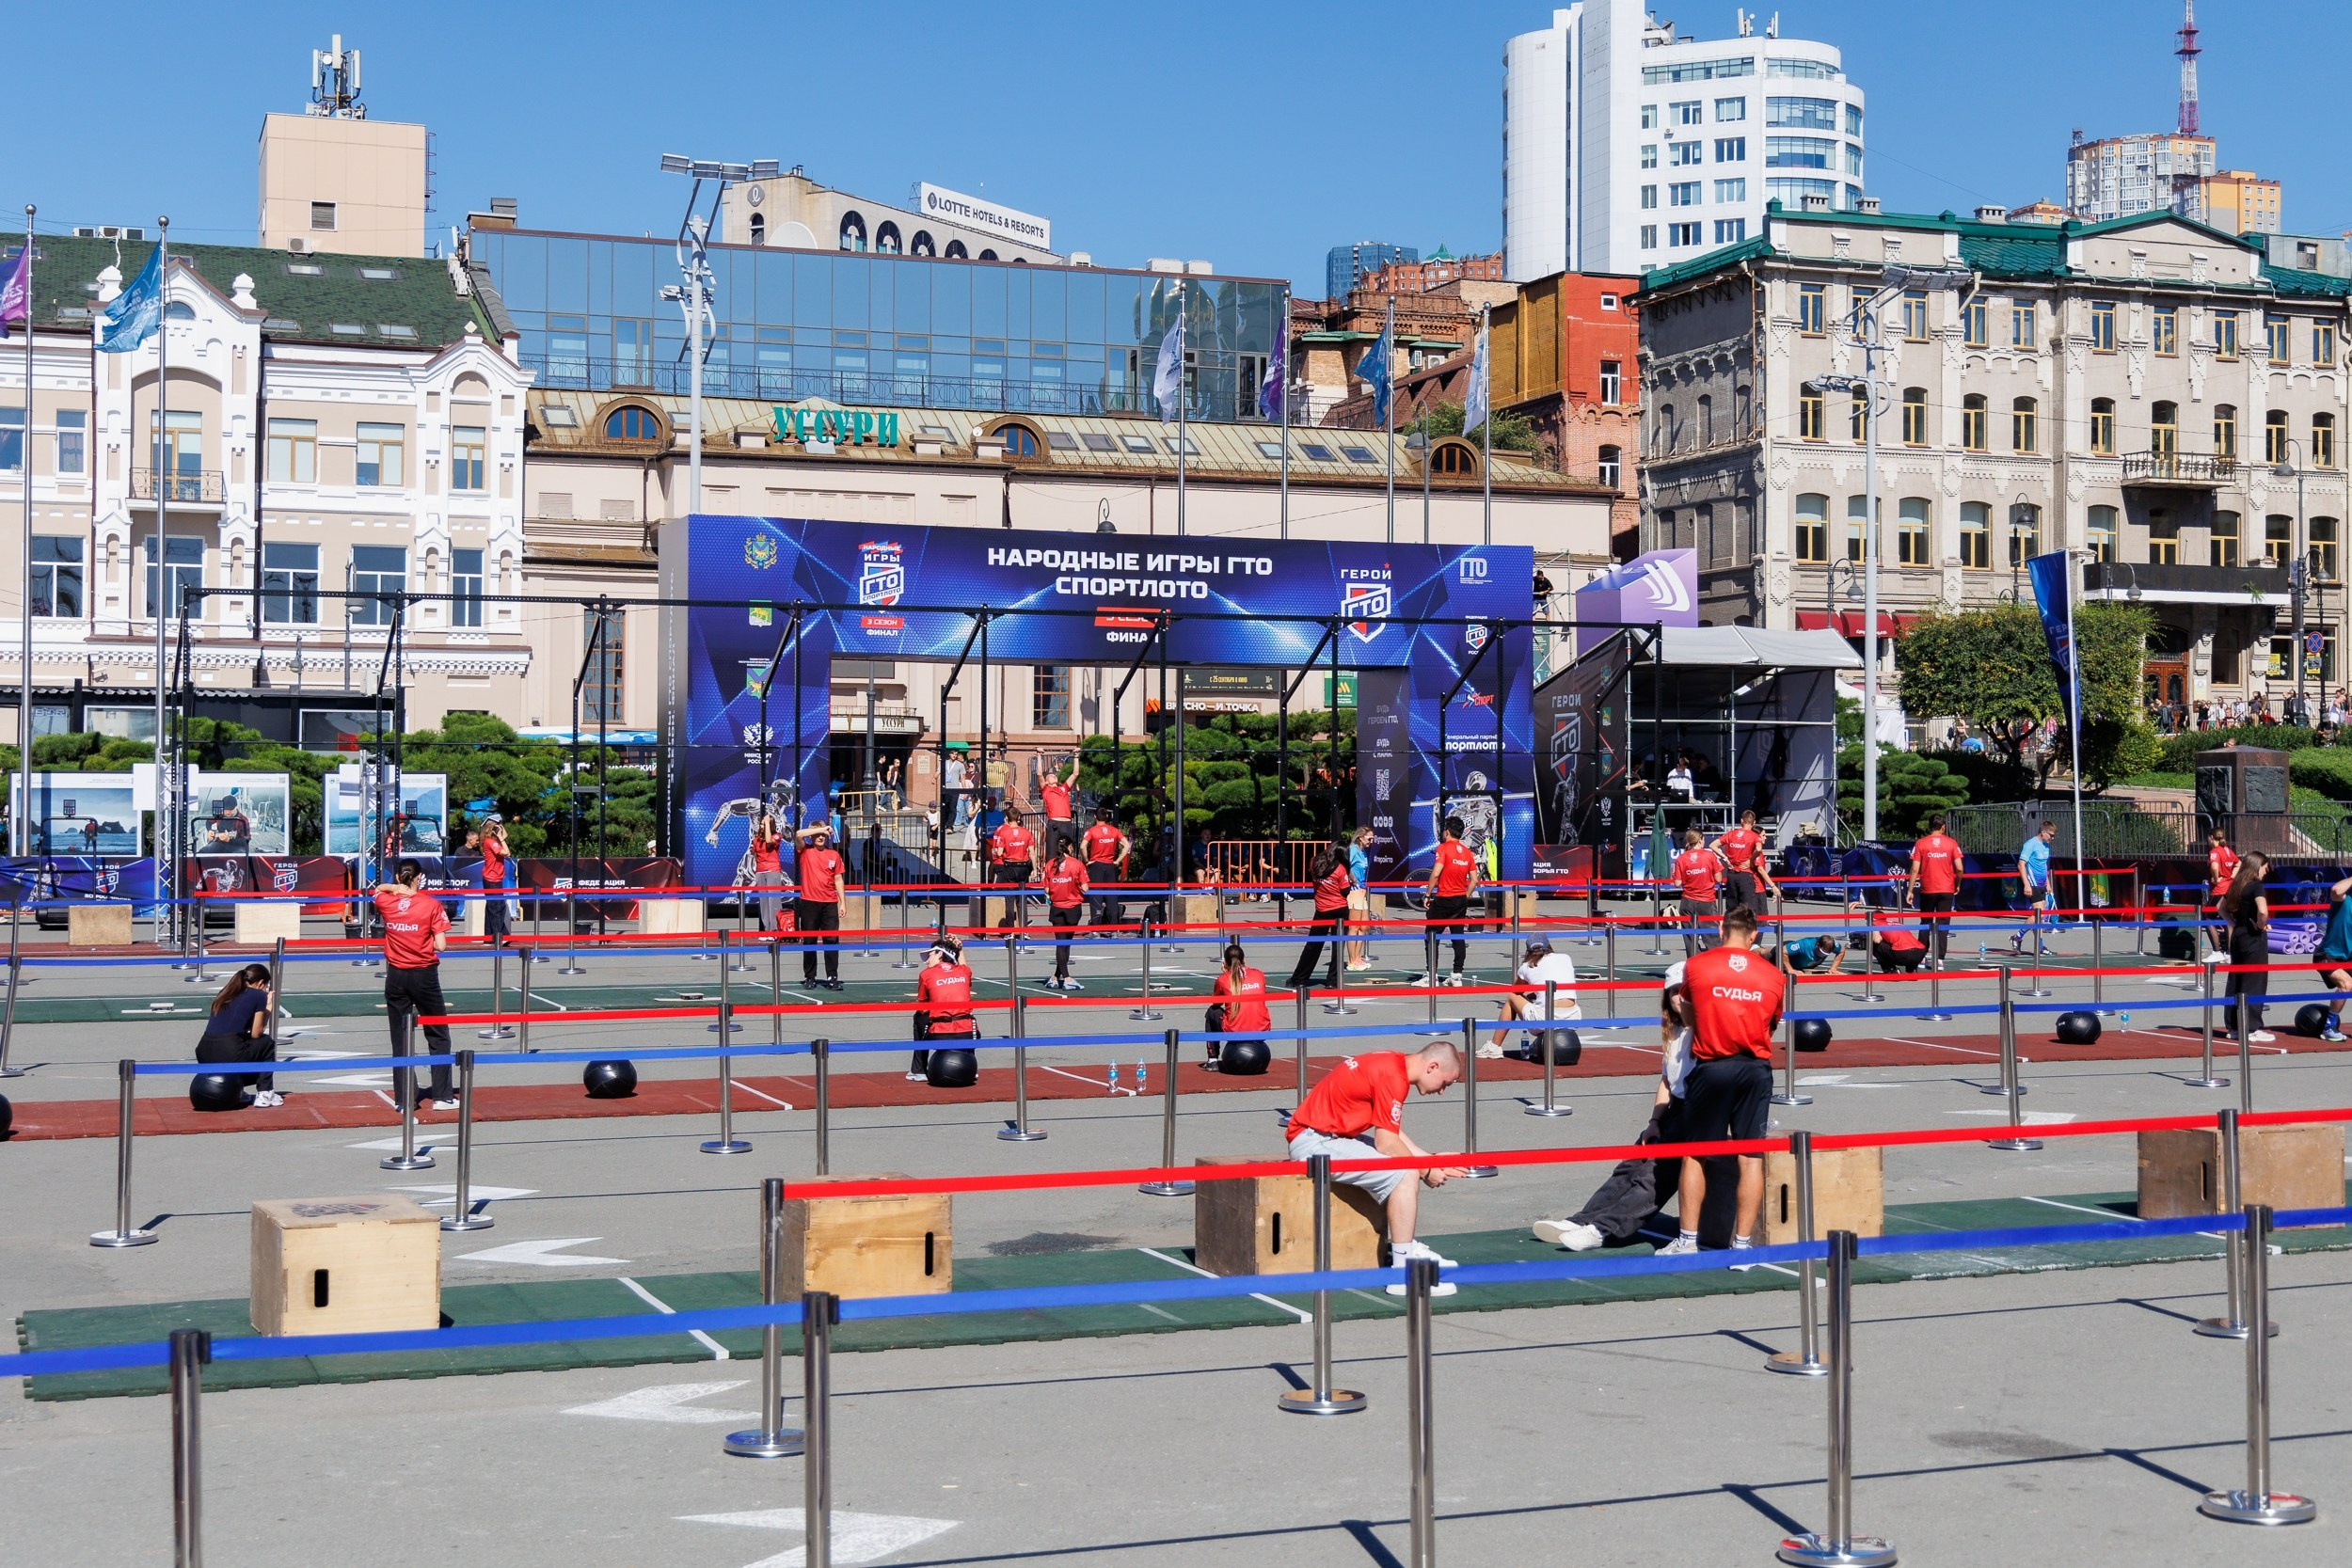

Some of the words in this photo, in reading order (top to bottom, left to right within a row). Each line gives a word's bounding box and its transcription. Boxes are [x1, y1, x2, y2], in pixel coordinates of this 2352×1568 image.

[938, 197, 971, 218] LOTTE
[973, 208, 1003, 227] HOTELS
[1004, 217, 1009, 229] &
[1010, 219, 1044, 239] RESORTS
[772, 406, 898, 447] УССУРИ
[864, 553, 900, 562] ИГРЫ
[988, 547, 1140, 572] НАРОДНЫЕ
[1147, 553, 1220, 574] ИГРЫ
[1227, 557, 1273, 576] ГТО
[1459, 557, 1487, 578] ГТО
[866, 573, 898, 594] ГТО
[1055, 576, 1209, 599] СПОРТЛОТО
[863, 587, 901, 602] СПОРТЛОТО
[1347, 595, 1385, 618] ГТО
[874, 618, 898, 626] СЕЗОН
[866, 628, 898, 637] ФИНАЛ
[1469, 628, 1485, 640] ГТО
[1452, 692, 1467, 704] НАШ
[1474, 694, 1495, 706] СПОРТ
[1216, 703, 1224, 711] И
[1225, 703, 1260, 712] ТОЧКА
[1376, 738, 1390, 748] БУДЬ
[1445, 741, 1506, 752] портлот
[1686, 867, 1707, 876] СУДЬЯ
[277, 874, 295, 885] ГТО
[1052, 876, 1073, 884] СУДЬЯ
[387, 922, 419, 931] СУДЬЯ
[936, 976, 966, 987] СУДЬЯ
[1241, 982, 1260, 991] ДЬЯ
[1712, 986, 1763, 1003] СУДЬЯ
